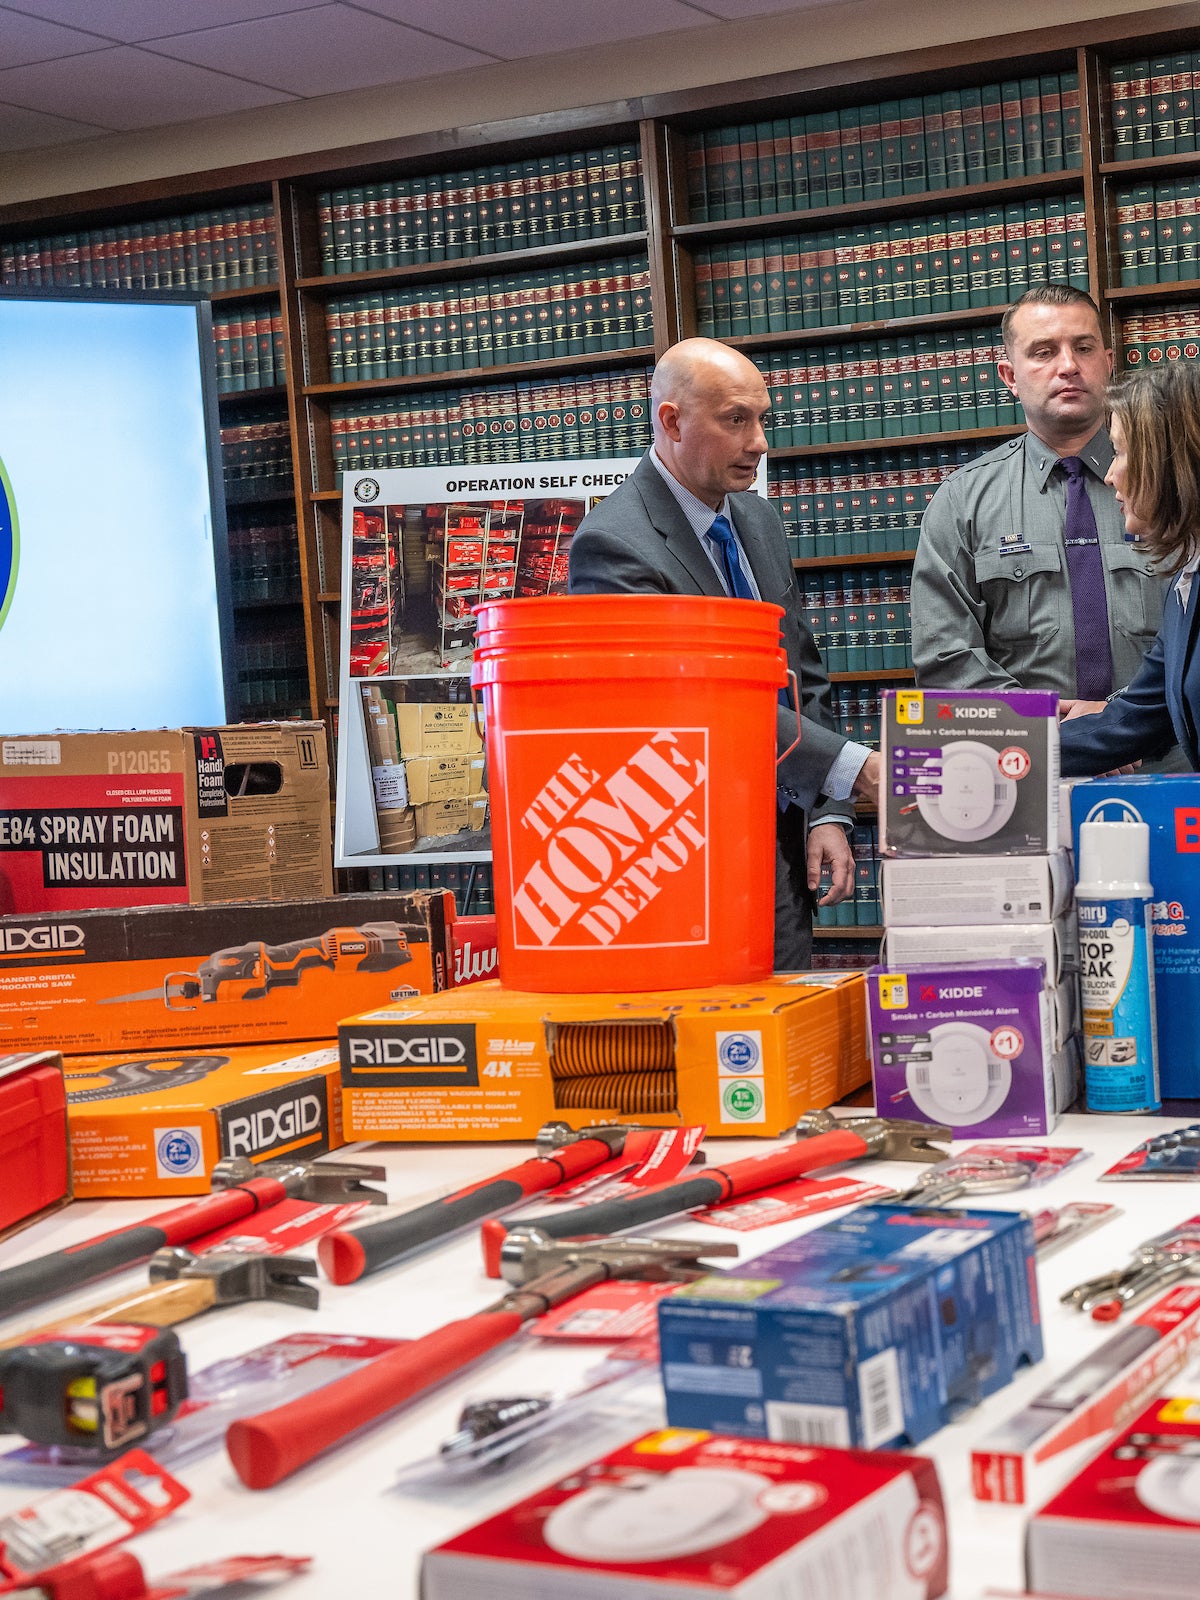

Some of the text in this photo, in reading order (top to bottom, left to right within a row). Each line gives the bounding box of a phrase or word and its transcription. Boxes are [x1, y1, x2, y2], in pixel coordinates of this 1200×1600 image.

[446, 477, 535, 493] OPERATION
[540, 476, 577, 489] SELF
[956, 708, 997, 719] KIDDE
[906, 728, 1028, 737] Smoke Carbon Monoxide Alarm
[108, 750, 171, 775] P12055
[198, 759, 223, 774] Handi
[1006, 757, 1020, 770] #1
[199, 774, 223, 788] Foam
[200, 789, 225, 799] Completely
[520, 752, 601, 841] THE
[0, 814, 174, 845] E84 SPRAY FOAM
[512, 730, 706, 946] HOME
[49, 851, 176, 880] INSULATION
[578, 809, 706, 946] DEPOT
[1080, 905, 1107, 923] enry
[0, 924, 85, 951] IDGID
[1152, 924, 1187, 936] reme
[1080, 943, 1114, 960] TOP
[1082, 961, 1114, 978] EAK
[391, 990, 419, 998] LIFETIME
[939, 987, 983, 999] KIDDE
[891, 1007, 1019, 1021] Smoke Carbon Monoxide Alarm
[350, 1037, 465, 1064] RIDGID
[999, 1036, 1013, 1049] #1
[482, 1061, 512, 1078] 4X
[228, 1094, 322, 1157] RIDGID
